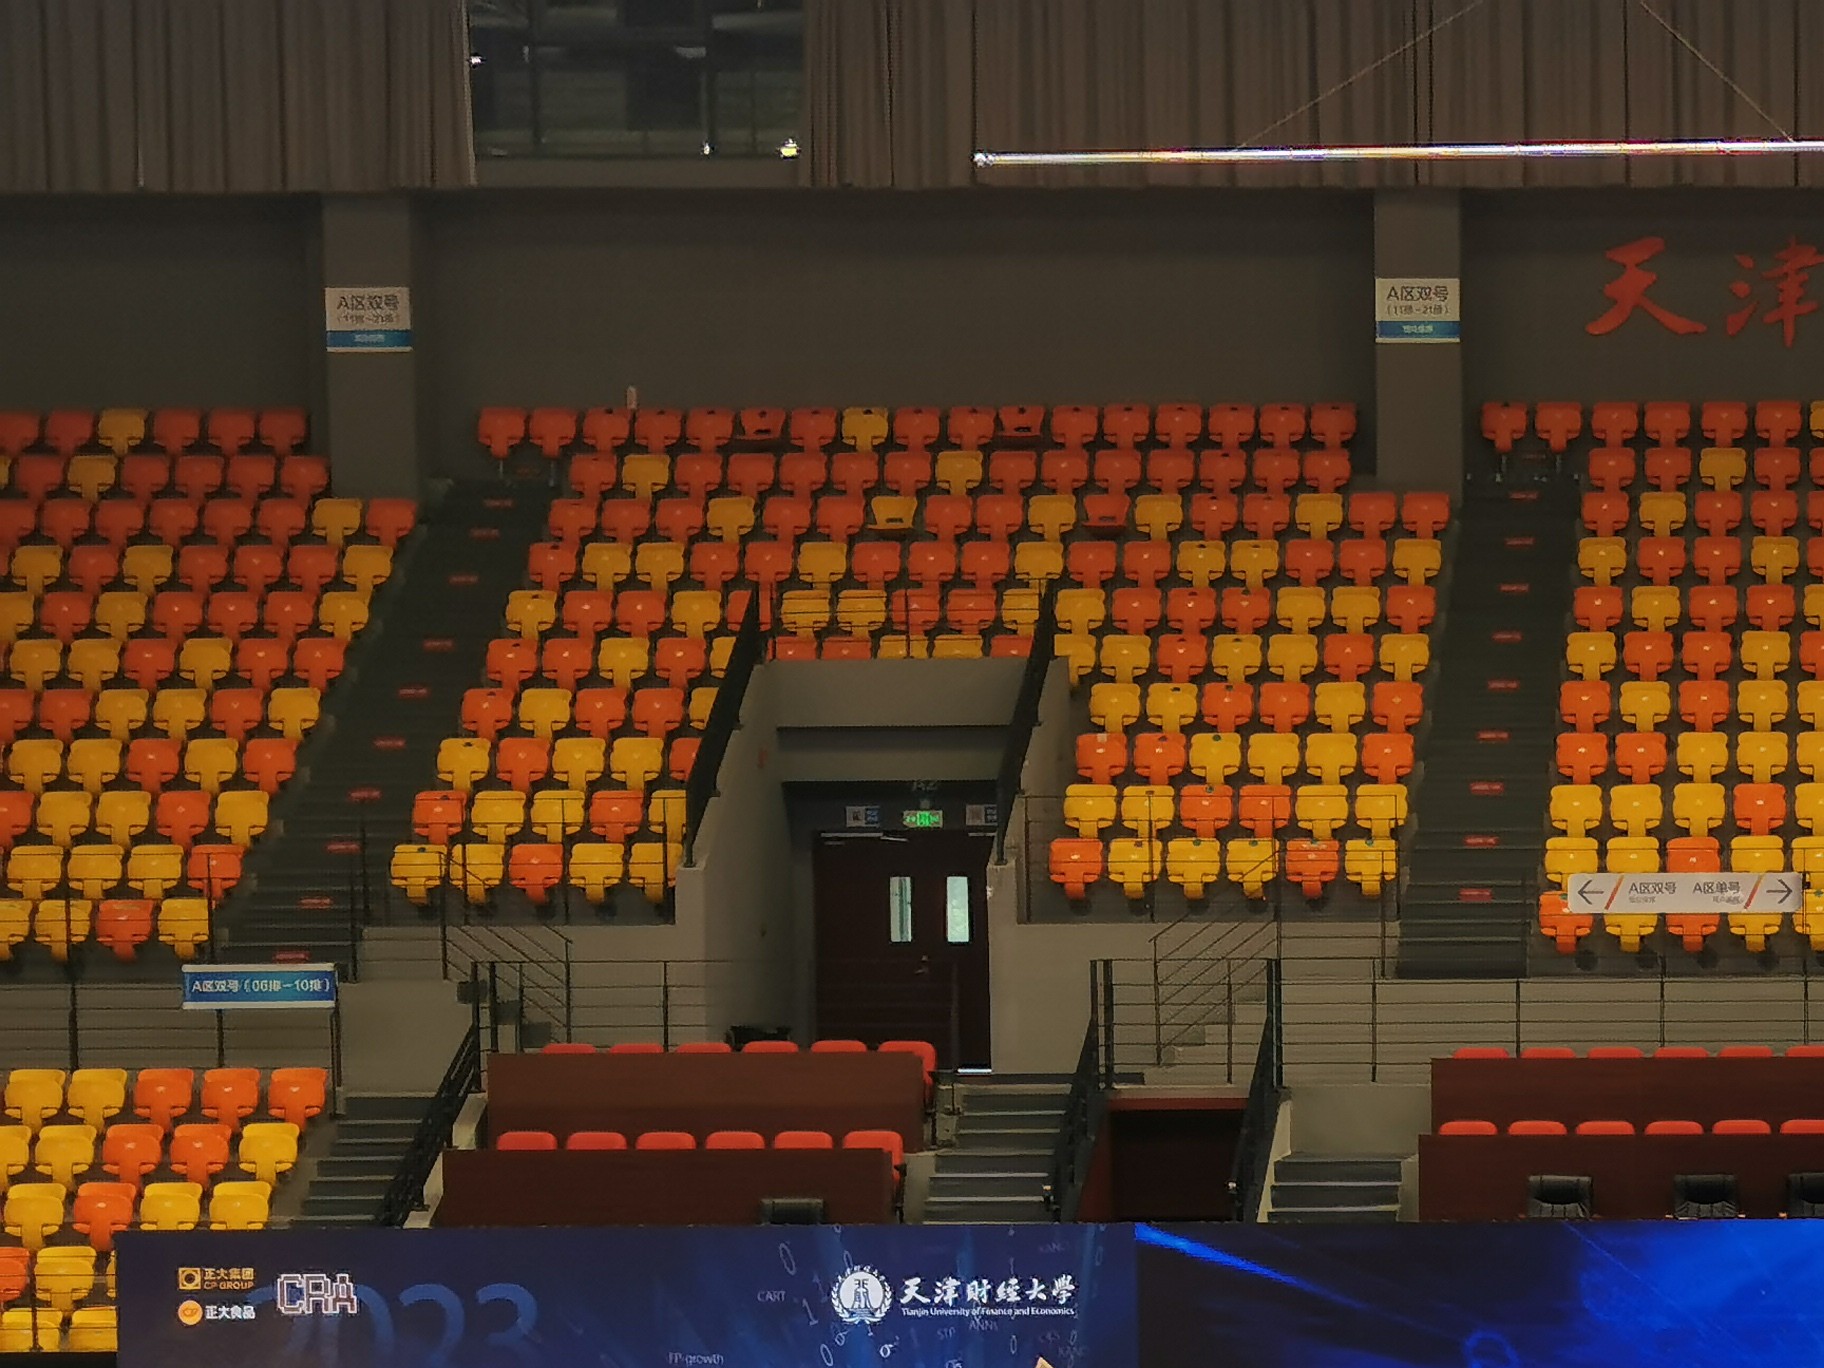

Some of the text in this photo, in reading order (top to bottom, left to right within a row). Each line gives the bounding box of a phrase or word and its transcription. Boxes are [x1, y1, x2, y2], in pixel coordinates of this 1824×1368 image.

[1628, 881, 1741, 895] A区双号 A区单号
[203, 1267, 255, 1281] 正大集团
[277, 1273, 358, 1315] CRA
[902, 1307, 928, 1317] Tianjin
[930, 1307, 969, 1317] University
[1031, 1307, 1075, 1315] Economics
